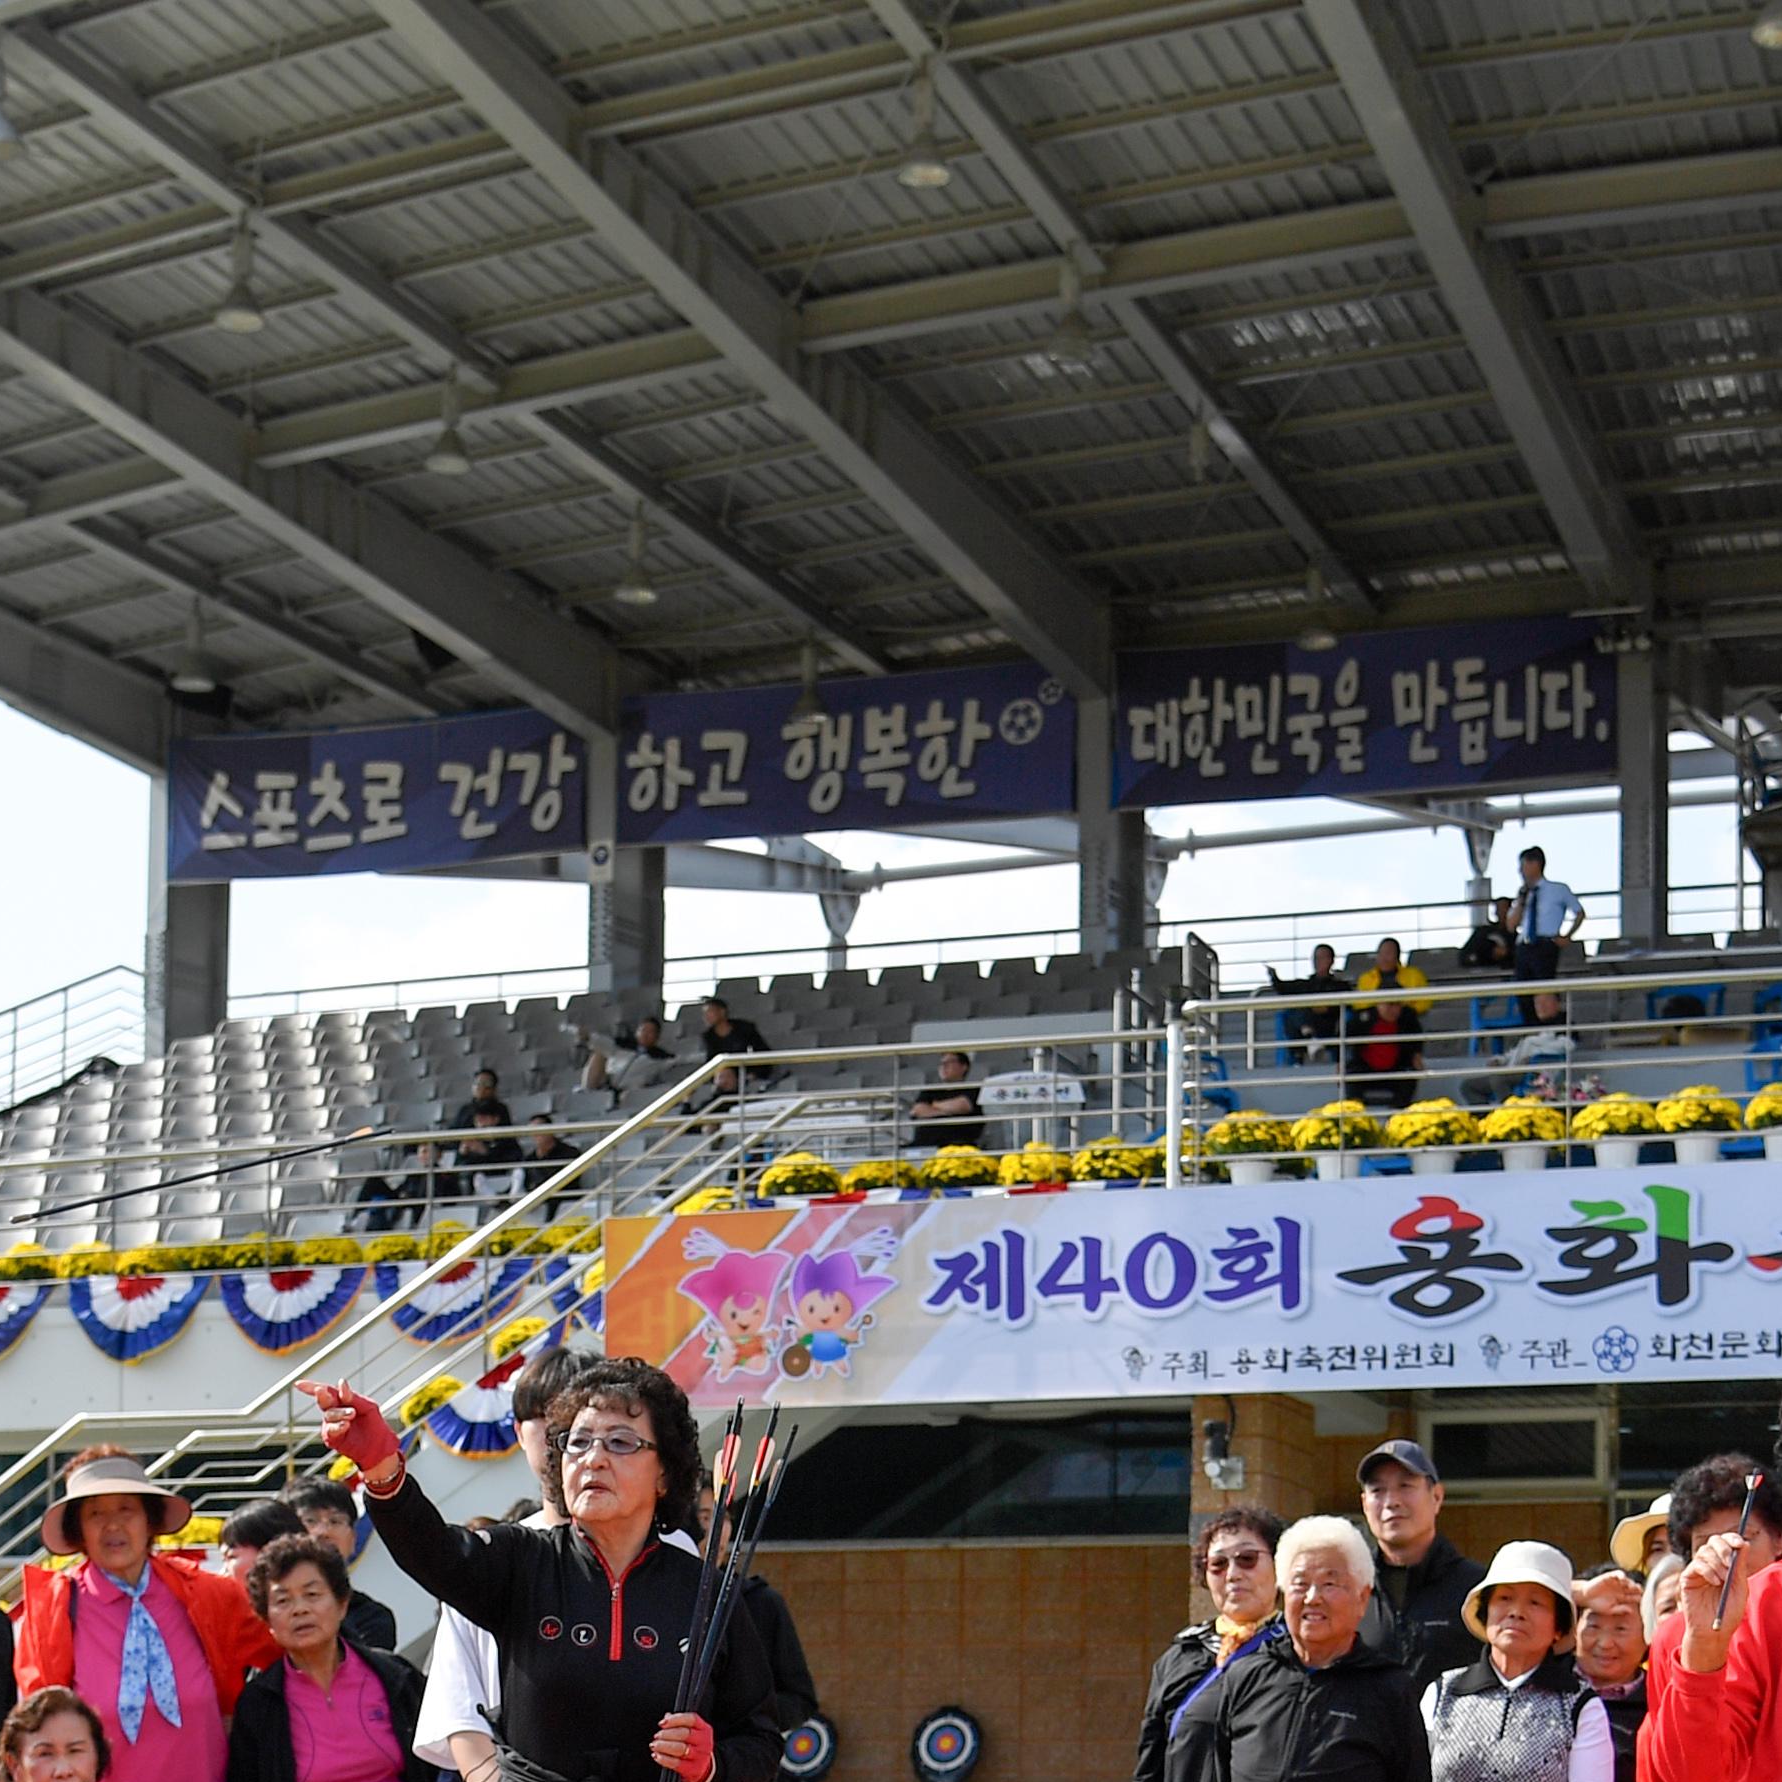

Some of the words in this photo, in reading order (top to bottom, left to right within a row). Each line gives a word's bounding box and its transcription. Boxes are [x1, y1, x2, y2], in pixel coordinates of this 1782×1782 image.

[199, 760, 409, 853] 스포츠로
[437, 732, 576, 842] 건강
[625, 729, 749, 812] 하고
[782, 695, 992, 813] 행복한
[1127, 656, 1366, 778] 대한민국을
[1391, 656, 1611, 765] 만듭니다.
[925, 1214, 1303, 1324] 제40회
[1230, 1342, 1455, 1376] 용화축전위원회
